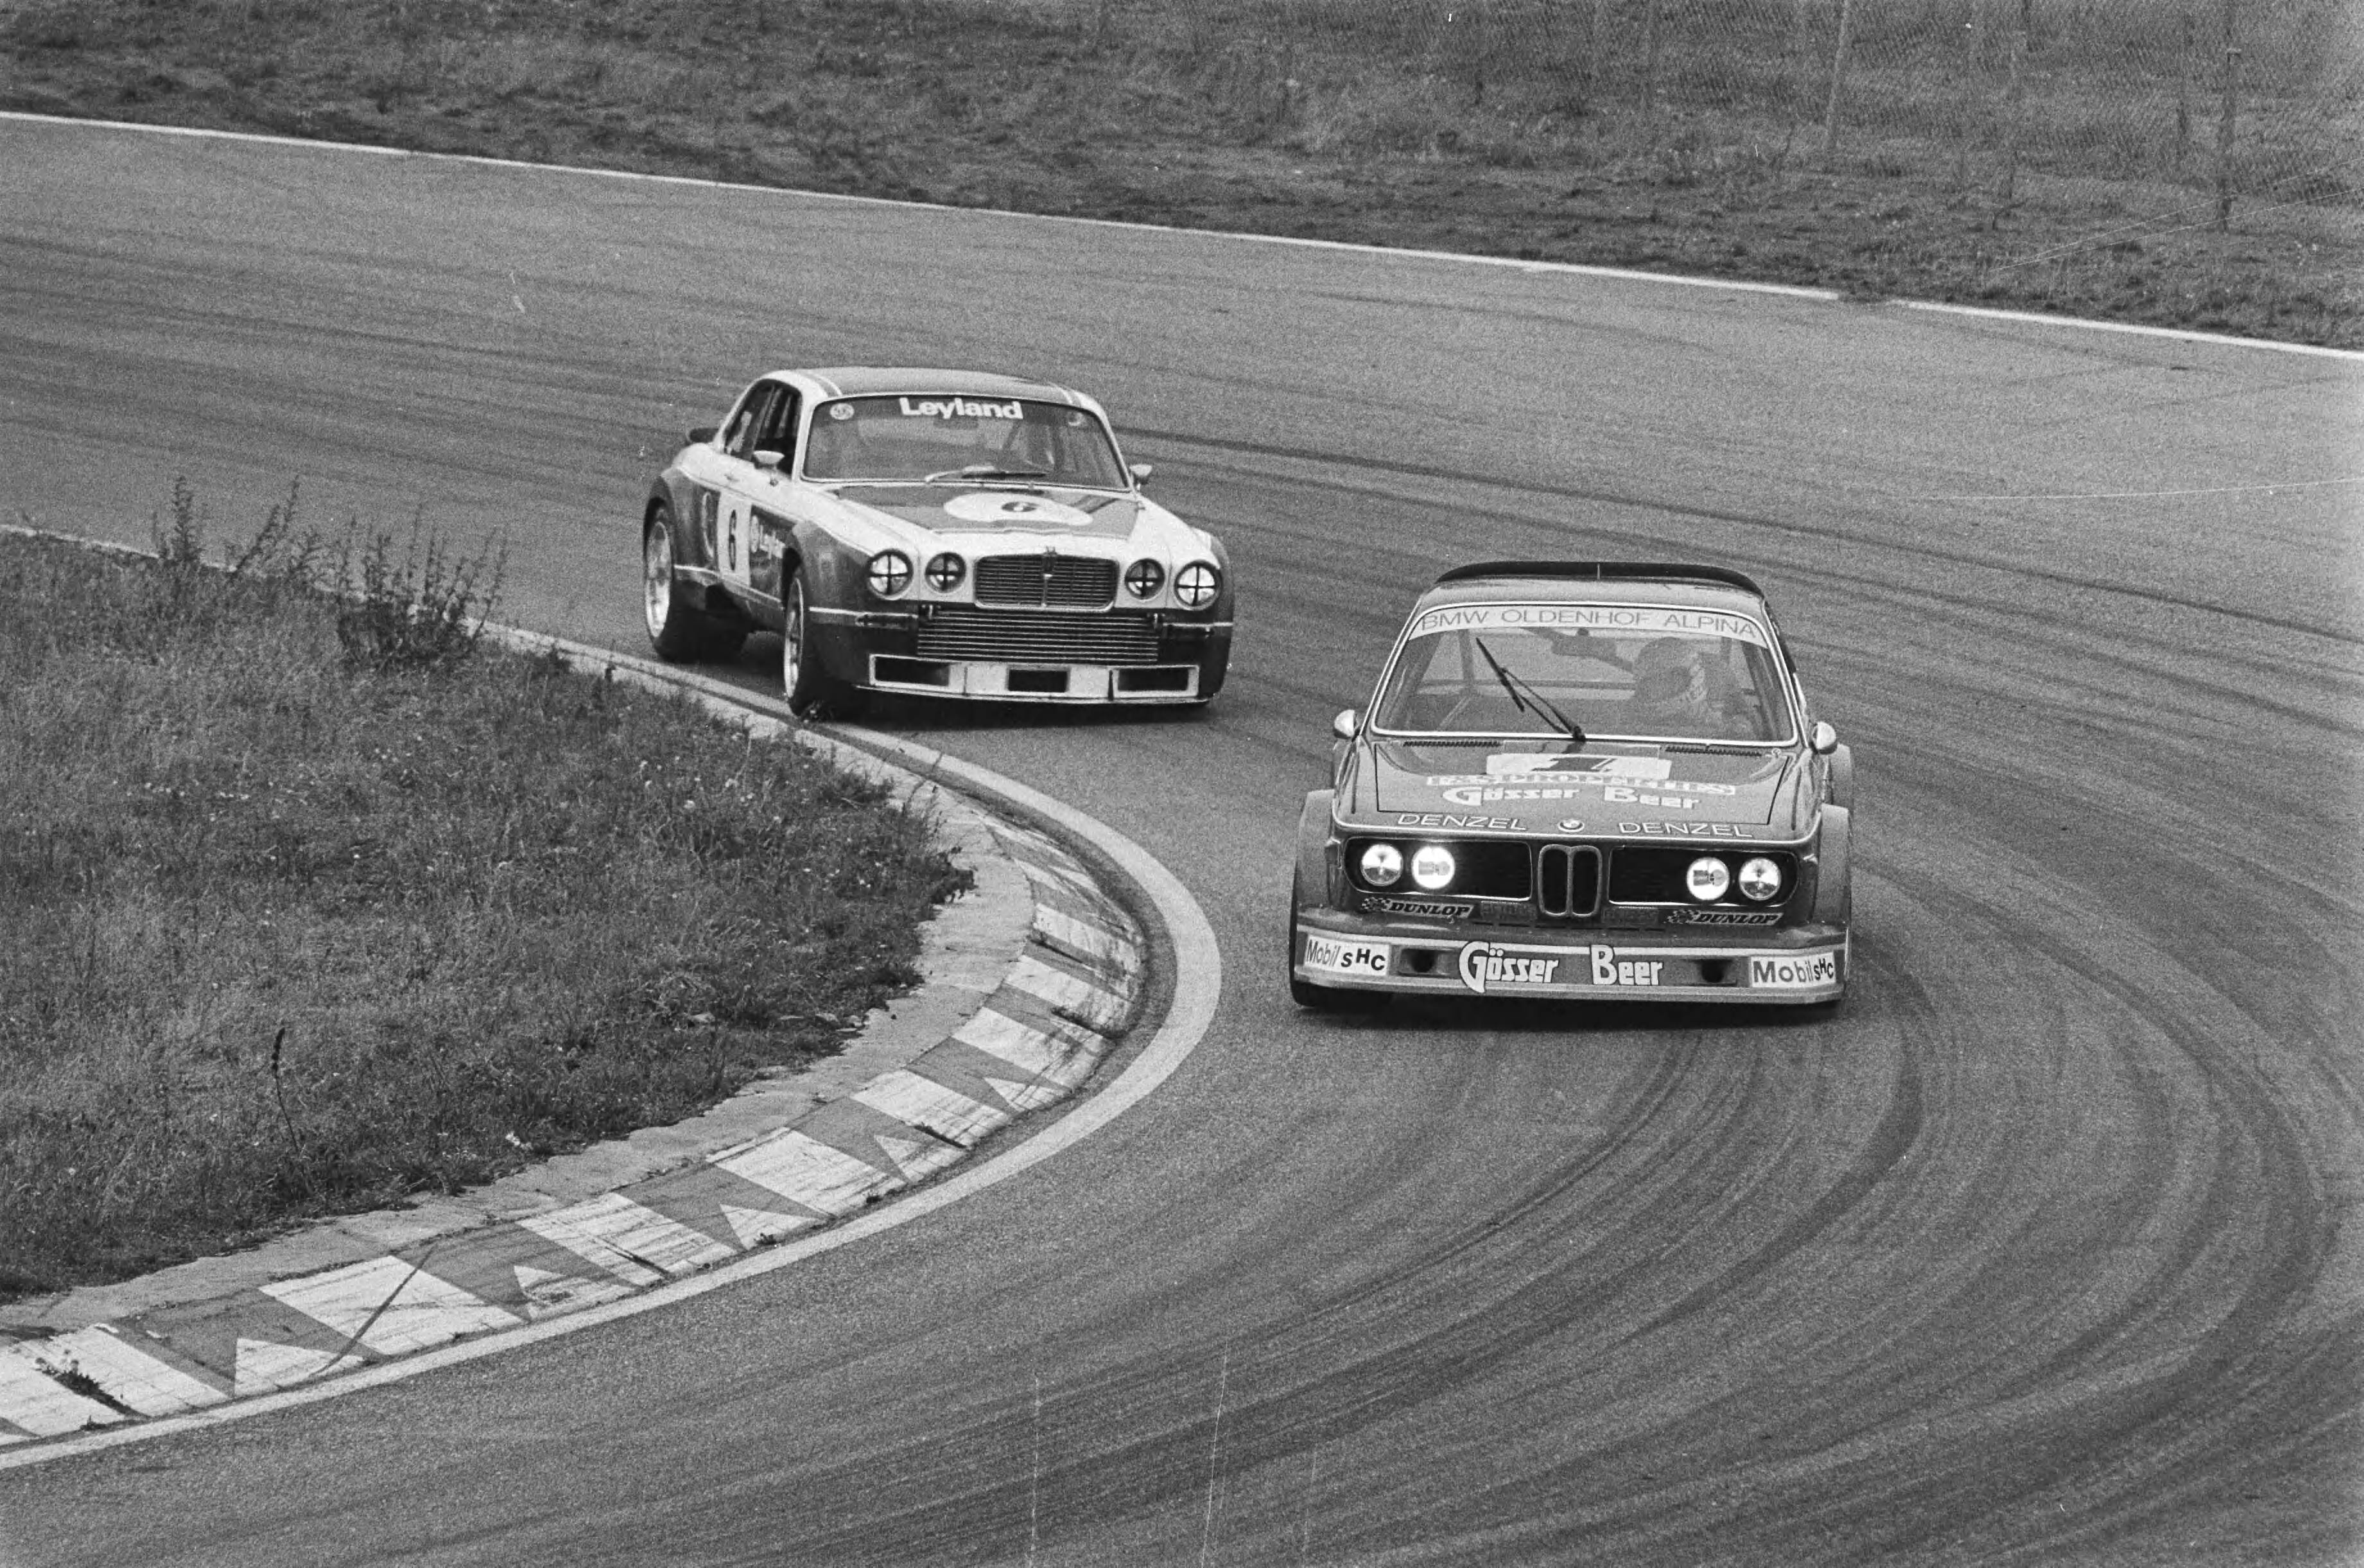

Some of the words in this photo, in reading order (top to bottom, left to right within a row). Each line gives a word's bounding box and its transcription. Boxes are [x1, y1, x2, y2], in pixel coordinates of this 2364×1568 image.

[899, 397, 1023, 419] Leyland
[1001, 500, 1039, 512] 6
[728, 509, 738, 571] 6
[1422, 611, 1489, 631] BMW
[1501, 609, 1649, 625] OLDENHOF
[1664, 614, 1755, 638] ALPINA
[1443, 786, 1579, 806] Gösser
[1604, 787, 1699, 809] Beer
[1397, 814, 1527, 830] DENZEL
[1618, 823, 1754, 837] DENZEL
[1389, 902, 1470, 916] DUNLOP
[1695, 913, 1778, 925] DUNLOP
[1307, 939, 1341, 967] Mobil
[1459, 941, 1559, 993] Gösser
[1590, 944, 1664, 986] Beer
[1753, 959, 1813, 983] Mobil
